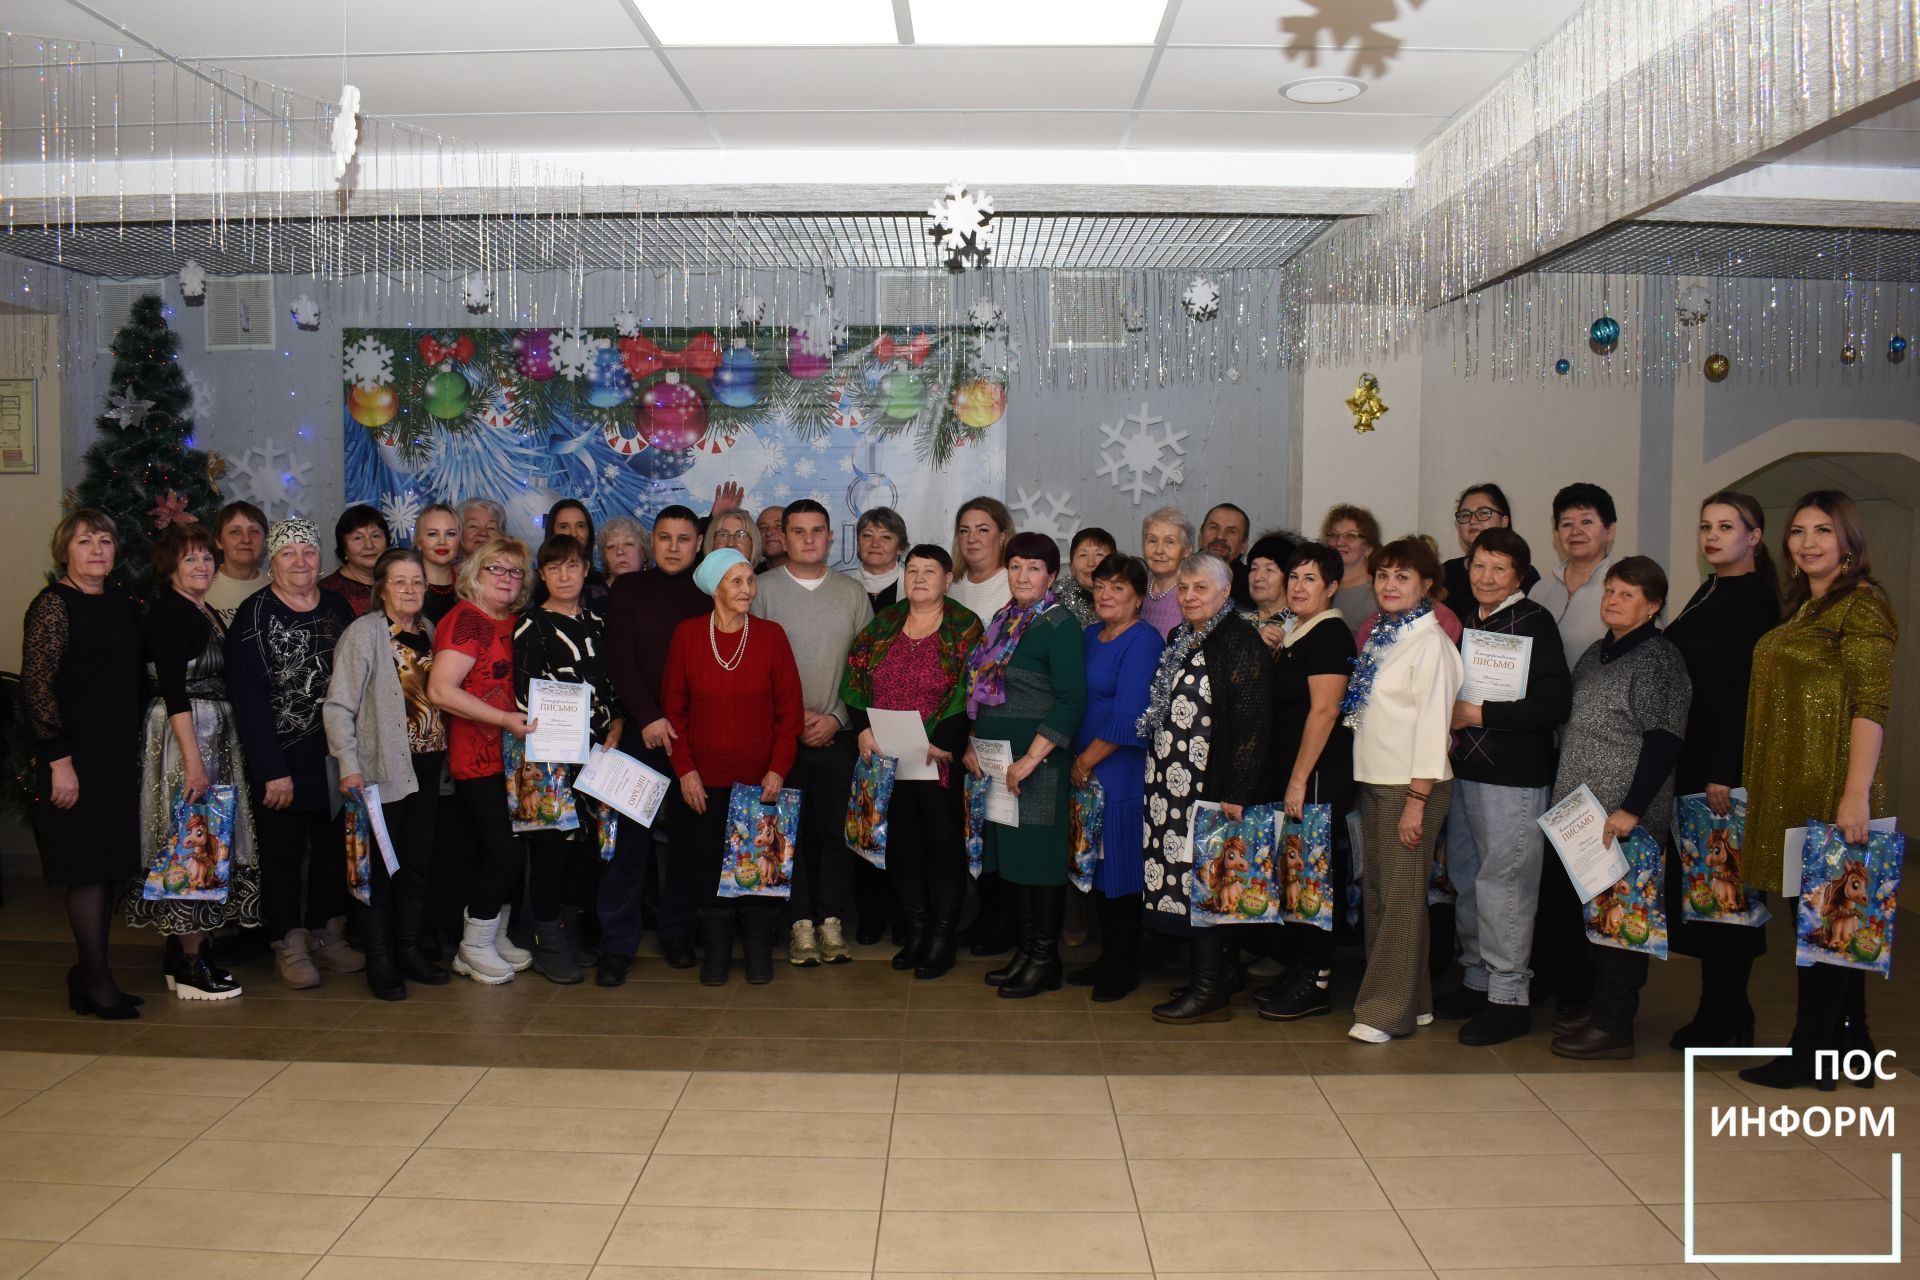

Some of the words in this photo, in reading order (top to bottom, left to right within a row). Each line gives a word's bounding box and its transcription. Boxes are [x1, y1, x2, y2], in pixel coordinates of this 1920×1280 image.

[1473, 656, 1515, 670] ПИСЬМО
[540, 703, 578, 712] ПИСЬМО
[628, 774, 647, 806] ПИСЬМО
[1561, 814, 1595, 842] ПИСЬМО
